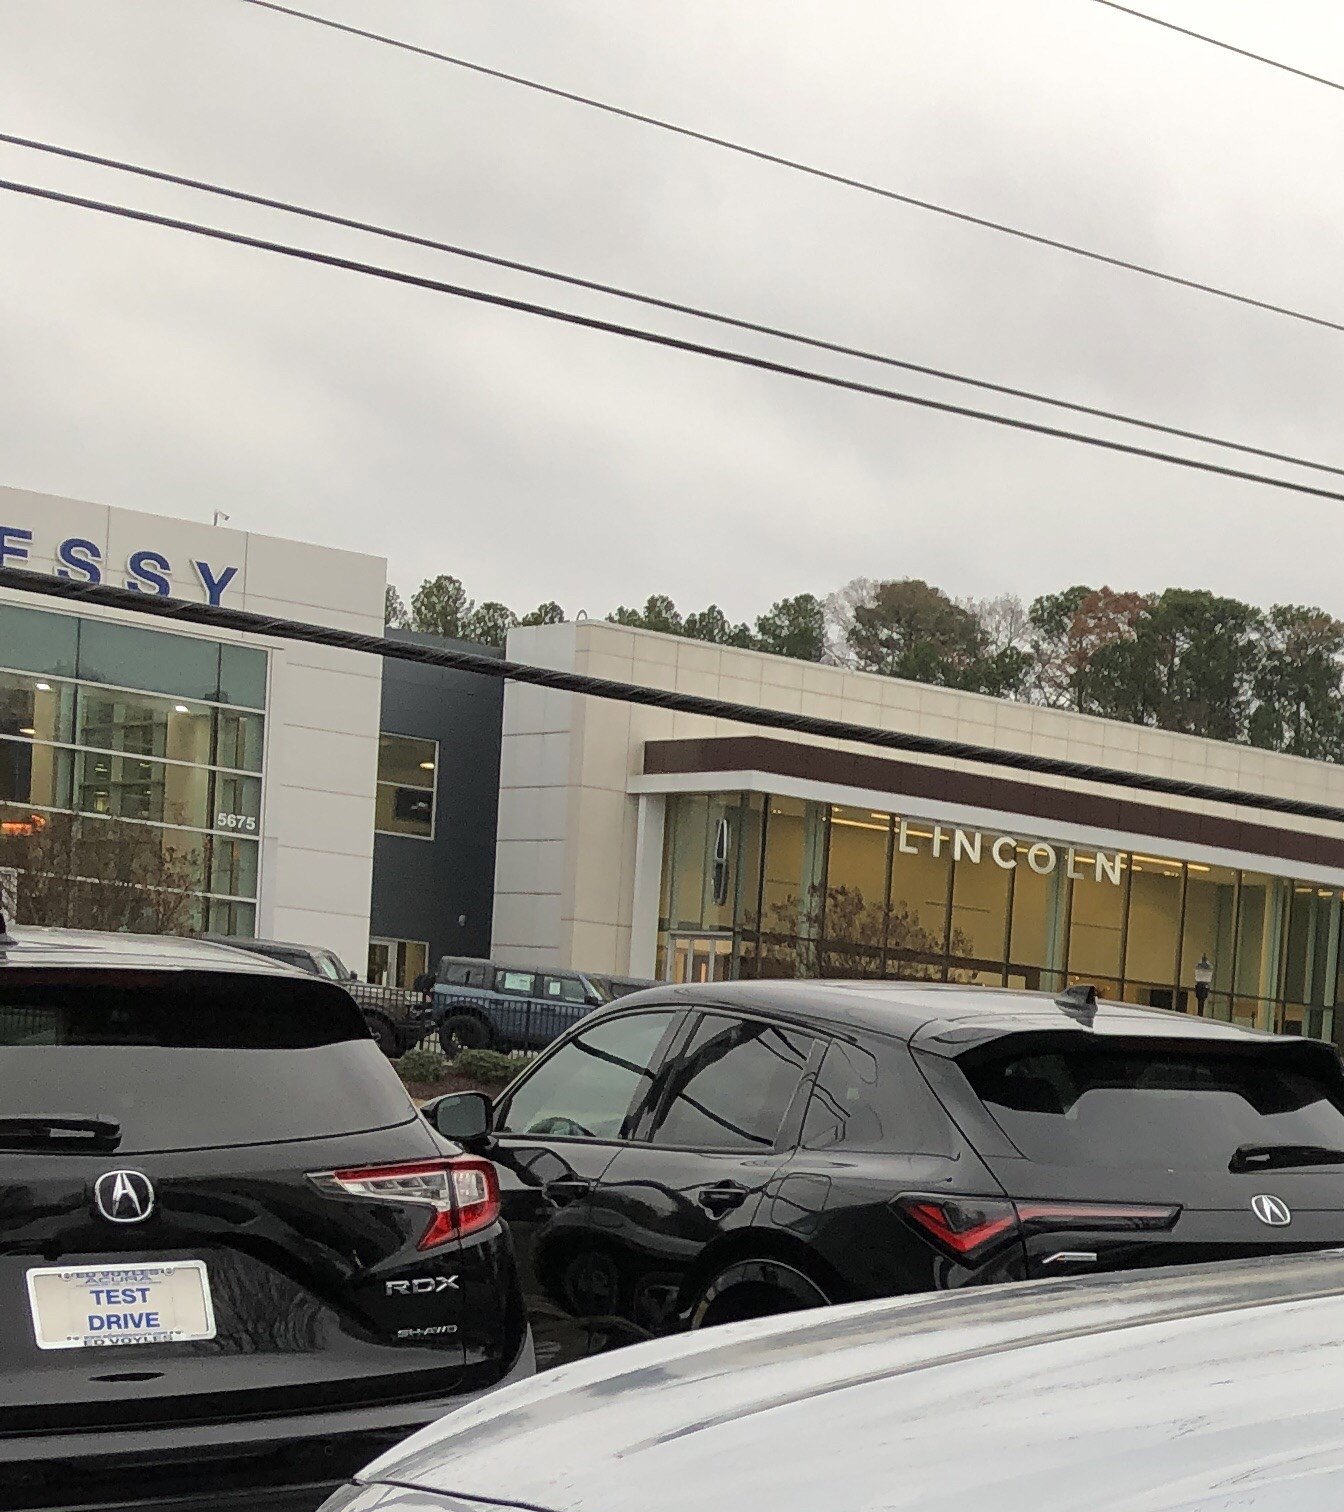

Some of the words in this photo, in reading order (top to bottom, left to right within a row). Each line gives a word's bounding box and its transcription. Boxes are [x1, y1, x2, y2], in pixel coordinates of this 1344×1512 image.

[217, 812, 256, 831] 5675
[899, 819, 1121, 886] LINCOLN
[385, 1275, 459, 1296] RDX
[90, 1287, 151, 1305] TEST
[88, 1312, 161, 1331] DRIVE
